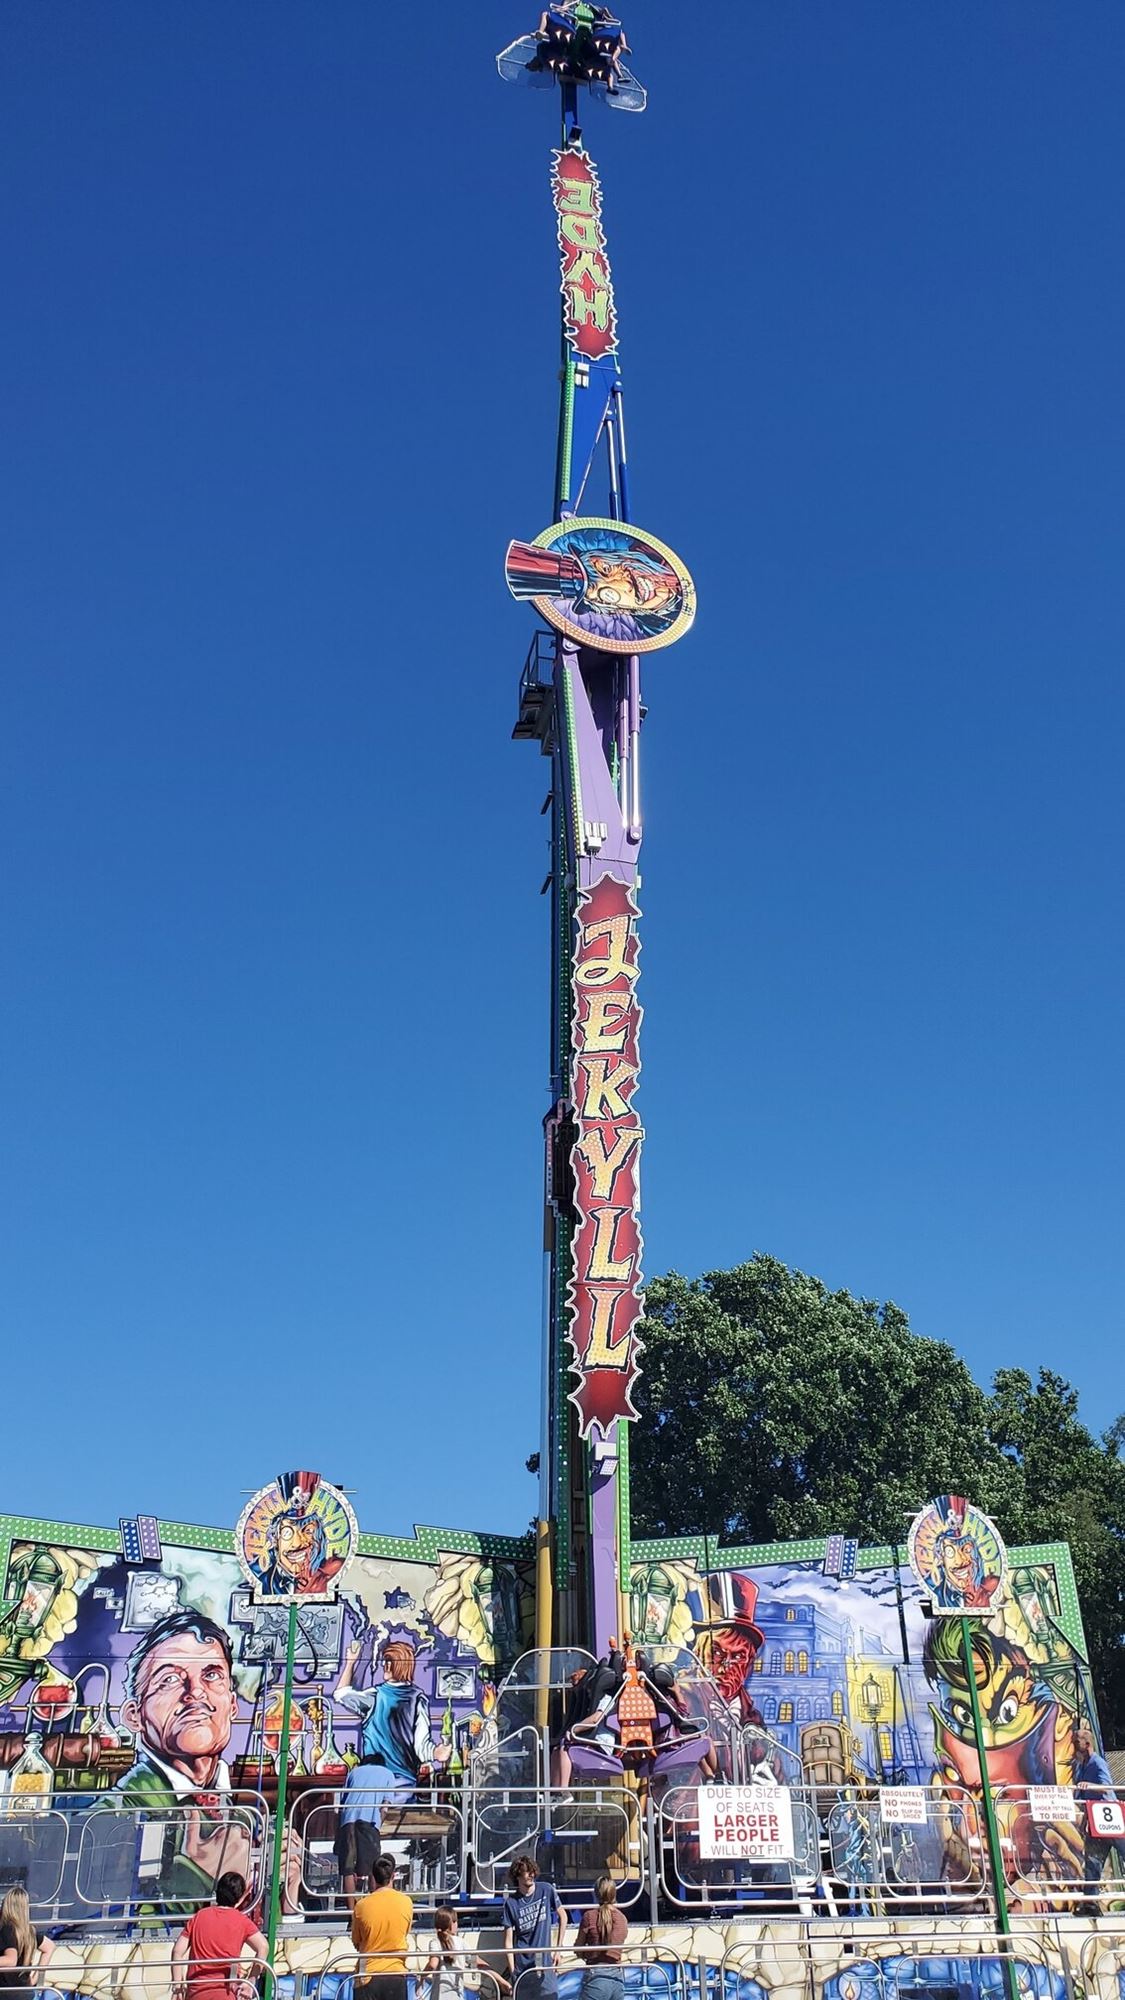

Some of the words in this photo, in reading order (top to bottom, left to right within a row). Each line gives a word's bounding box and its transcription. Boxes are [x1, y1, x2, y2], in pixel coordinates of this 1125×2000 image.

[558, 178, 609, 331] HYDE
[574, 913, 645, 1372] JEKYLL
[244, 1488, 292, 1572] JEKYLL
[306, 1488, 350, 1559] HYDE
[914, 1510, 948, 1587] JEKYLL
[962, 1510, 1001, 1578] HYDE
[707, 1788, 732, 1799] DUE
[736, 1788, 752, 1799] TO
[755, 1787, 781, 1798] SIZE
[881, 1790, 924, 1798] ABSOLUTELY
[716, 1802, 732, 1813] OF
[736, 1802, 774, 1813] SEATS
[885, 1799, 898, 1807] NO
[886, 1809, 899, 1818] NO
[1102, 1806, 1113, 1822] 8
[714, 1815, 778, 1827] LARGER
[1098, 1823, 1121, 1831] COUPONS
[714, 1829, 780, 1842] PEOPLE
[711, 1845, 737, 1856] WILL
[741, 1845, 764, 1855] NOT
[768, 1845, 784, 1855] FIT
